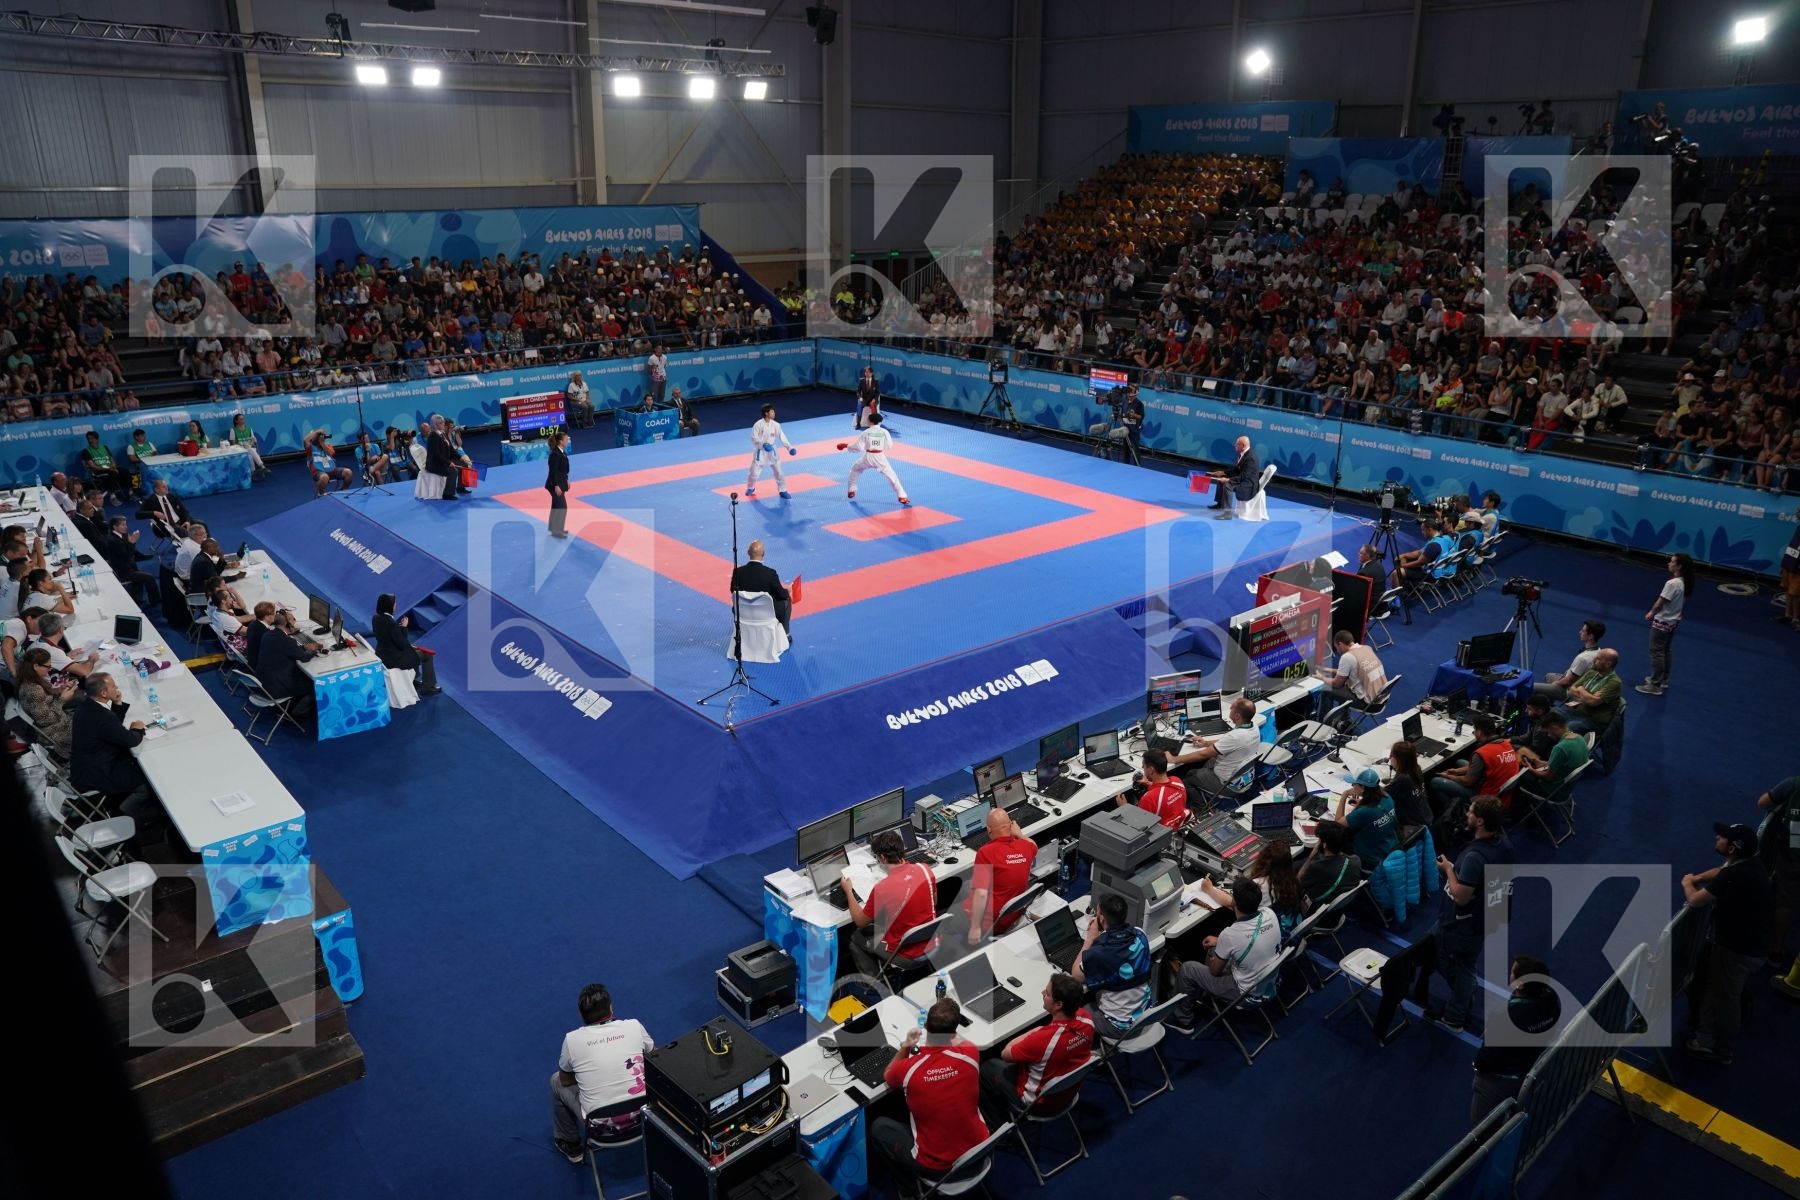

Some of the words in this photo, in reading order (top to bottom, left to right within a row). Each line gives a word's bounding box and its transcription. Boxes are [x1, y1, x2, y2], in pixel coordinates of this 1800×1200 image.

[1683, 106, 1756, 125] BUENOS
[1760, 104, 1800, 120] AIRE
[1165, 119, 1203, 131] BUENOS
[1205, 118, 1232, 130] AIRES
[1234, 117, 1258, 129] 2018
[1742, 127, 1773, 139] Feel
[545, 228, 593, 243] BUENOS
[595, 228, 624, 240] AIRES
[628, 227, 653, 239] 2018
[9, 249, 55, 266] 2018
[540, 425, 559, 436] 0:57
[645, 418, 670, 428] COACH
[1441, 453, 1469, 465] BUENOS
[1491, 462, 1507, 472] 2018
[1540, 471, 1571, 484] BUENOS
[1573, 476, 1595, 487] AIRES
[1597, 480, 1615, 491] 2018
[1651, 490, 1687, 504] BUENOS
[1688, 496, 1713, 508] AIRES
[1715, 501, 1736, 512] 2018
[330, 528, 354, 546] BUENOS
[348, 540, 366, 555] AIRES
[359, 548, 377, 563] 2018
[1278, 607, 1301, 621] OMEGA
[1312, 614, 1317, 628] 0
[1310, 638, 1316, 651] 0
[500, 641, 540, 670] BUENOS
[531, 662, 563, 686] AIRES
[555, 677, 584, 700] 2018
[1284, 660, 1307, 682] 0:57
[886, 700, 949, 730] BUENOS
[948, 686, 989, 710] AIRES
[986, 673, 1022, 696] 2018
[606, 1034, 625, 1043] futuro
[923, 1070, 959, 1083] TIMEKEEPER
[926, 1066, 954, 1075] OFFICIAL
